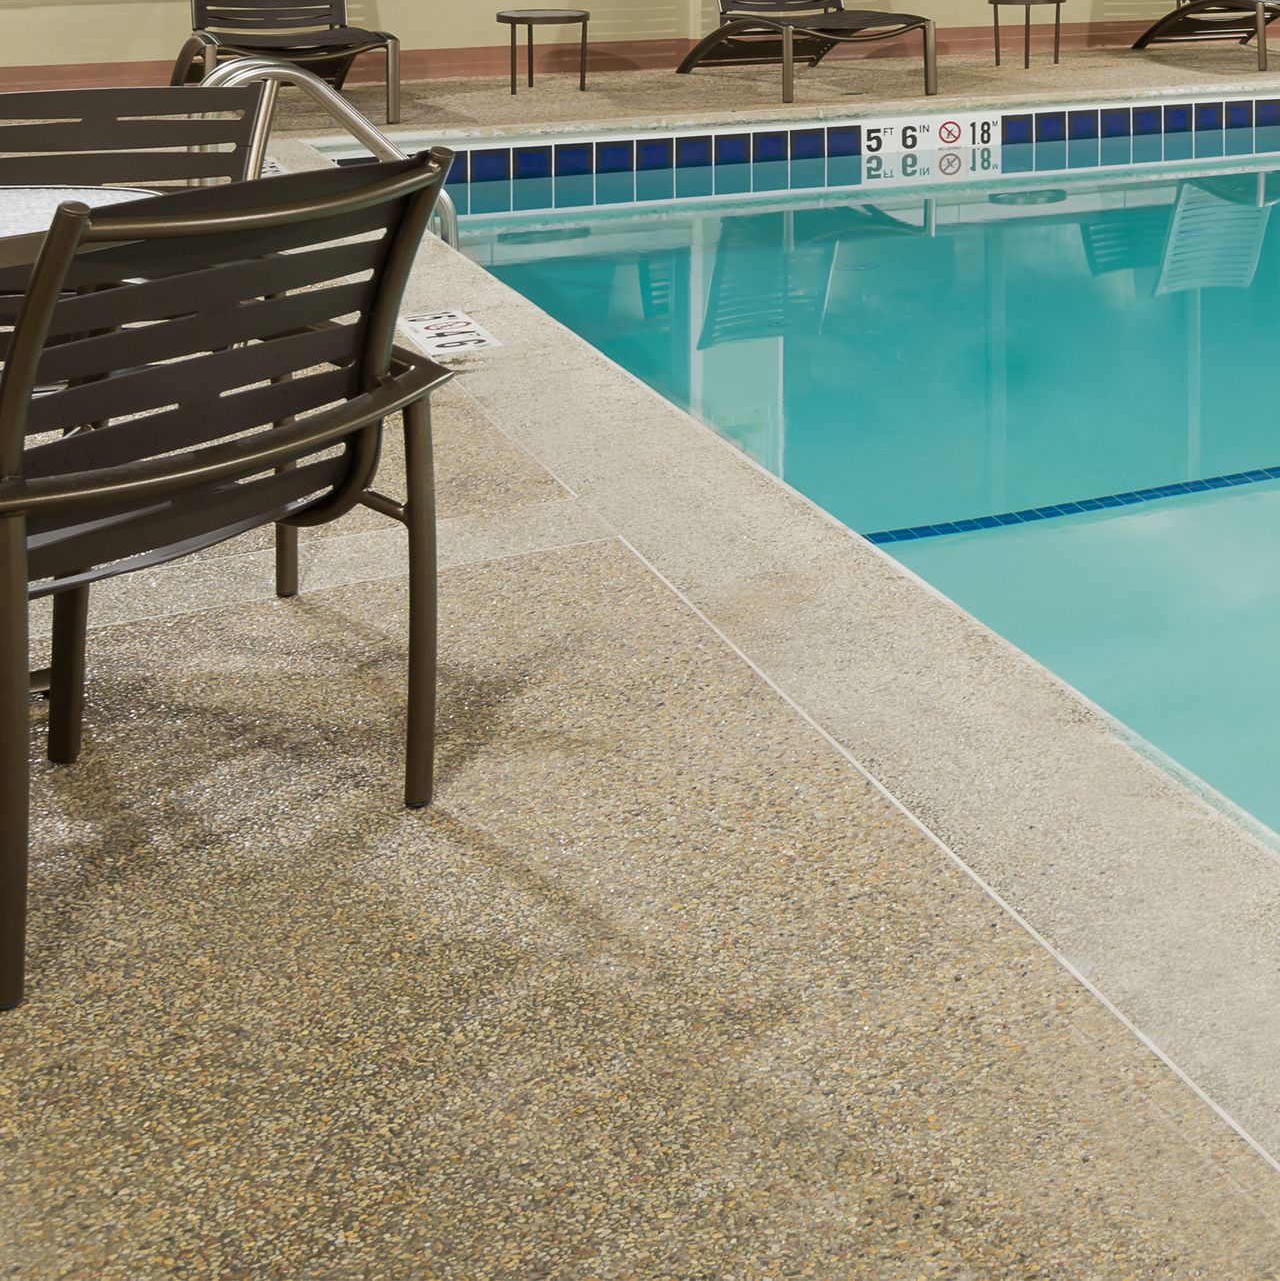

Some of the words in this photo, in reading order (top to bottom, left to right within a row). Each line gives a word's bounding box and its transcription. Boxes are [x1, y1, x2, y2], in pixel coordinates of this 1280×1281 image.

[866, 128, 882, 152] 5
[883, 127, 894, 136] FT
[902, 125, 917, 149] 6
[919, 124, 930, 133] IN
[970, 121, 991, 145] 1.8
[435, 338, 486, 348] 6
